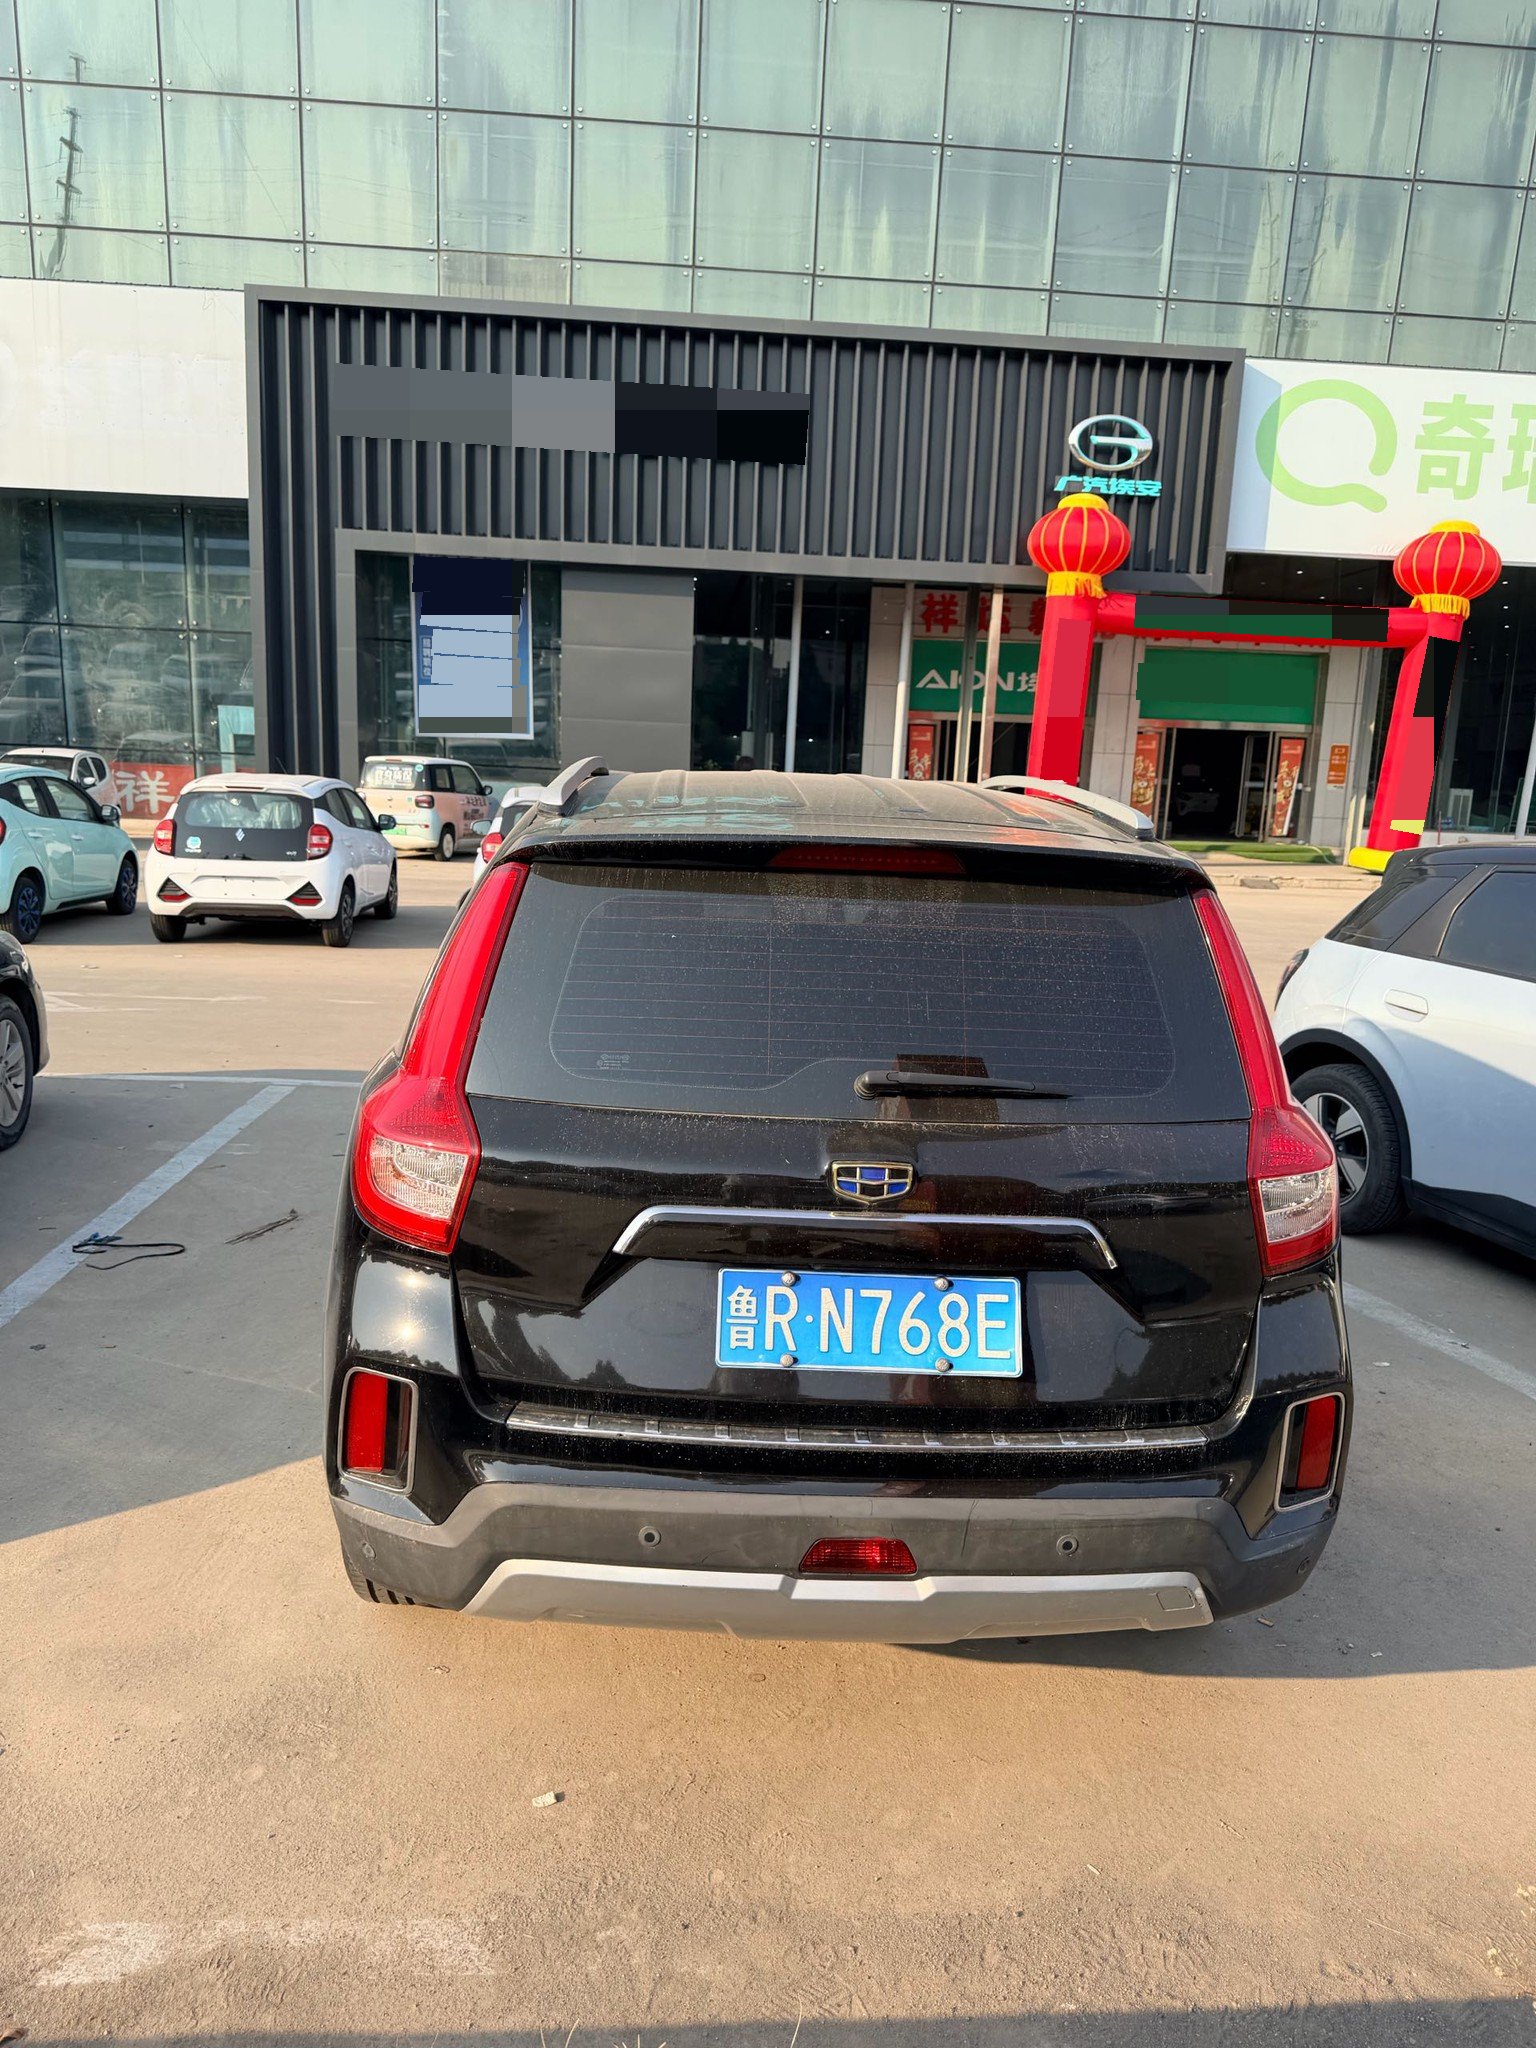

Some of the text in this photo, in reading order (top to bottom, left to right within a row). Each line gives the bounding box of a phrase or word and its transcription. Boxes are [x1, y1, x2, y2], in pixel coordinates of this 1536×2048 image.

[1053, 475, 1162, 497] 广汽埃安
[115, 770, 175, 814] 祥
[726, 1285, 1012, 1359] 鲁R·N768E
